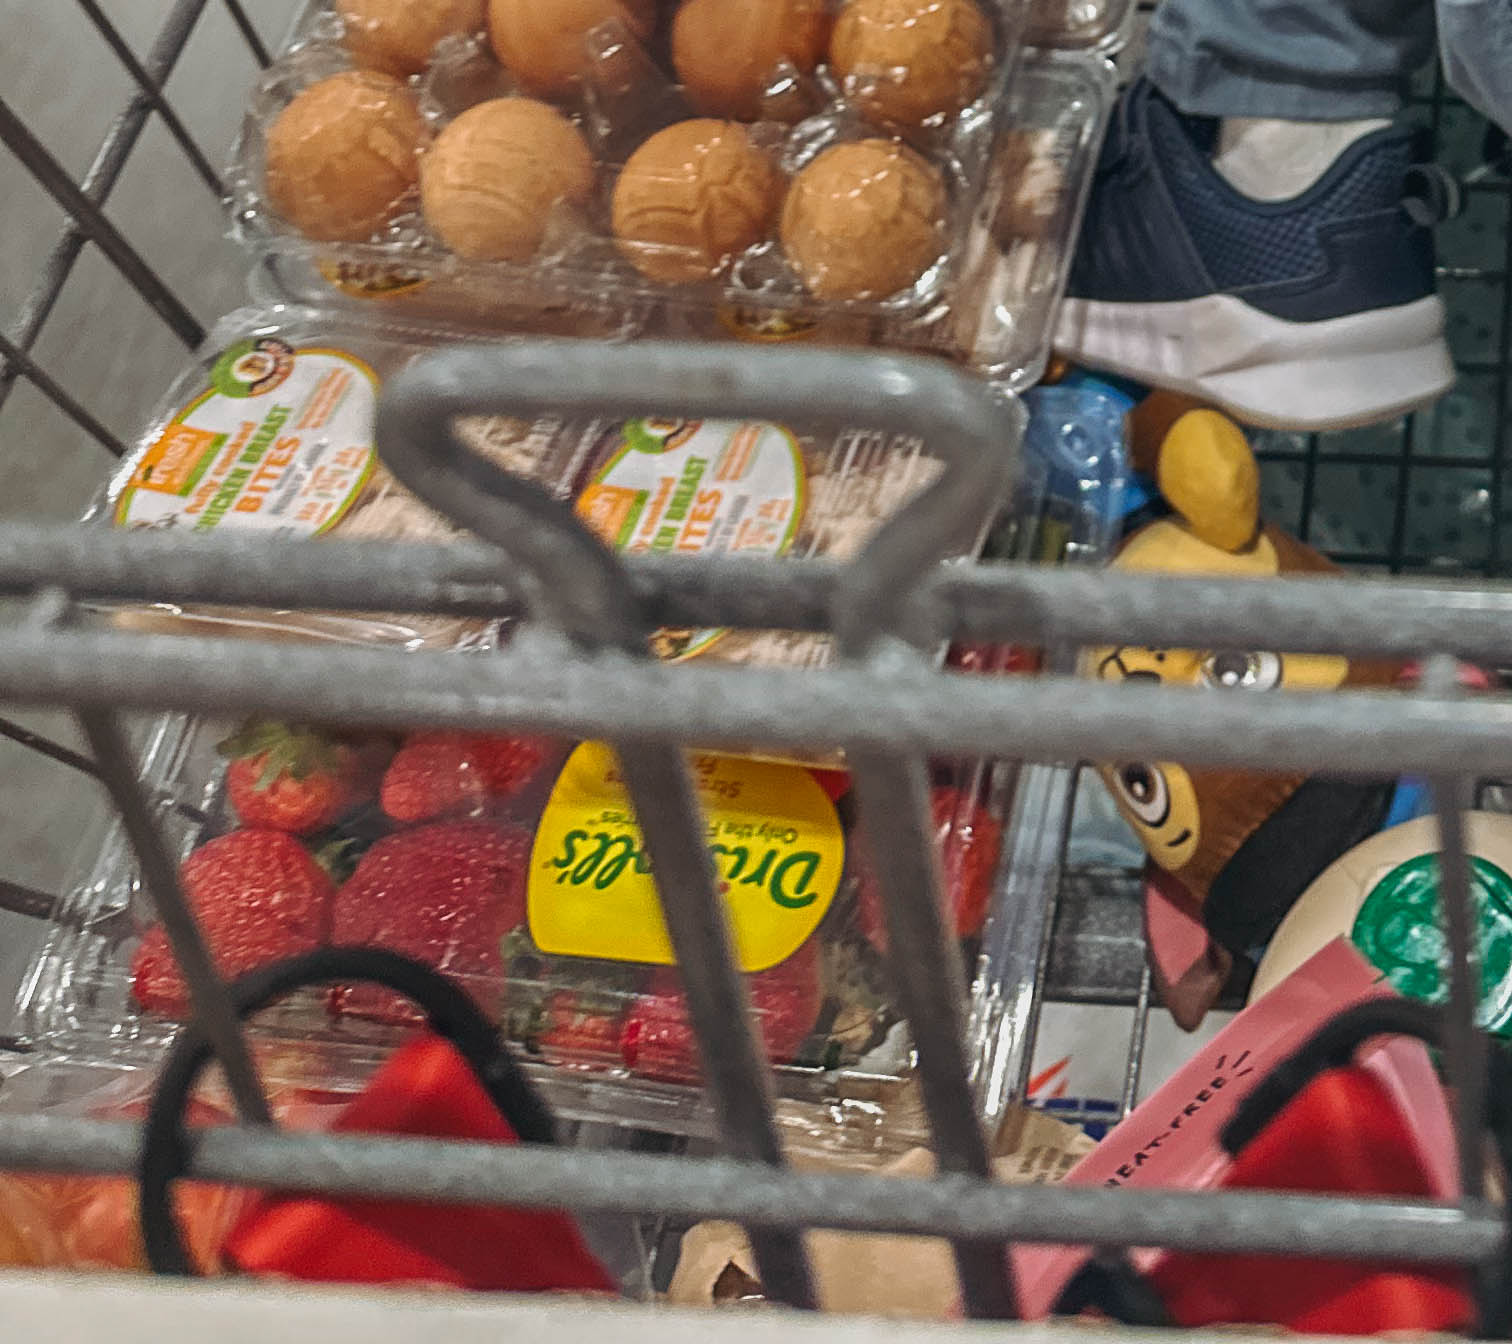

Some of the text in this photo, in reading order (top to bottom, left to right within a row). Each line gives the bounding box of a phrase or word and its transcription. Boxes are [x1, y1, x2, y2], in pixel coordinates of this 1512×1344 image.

[232, 435, 301, 513] BITES
[675, 488, 724, 551] ITES
[552, 828, 822, 910] Drill's
